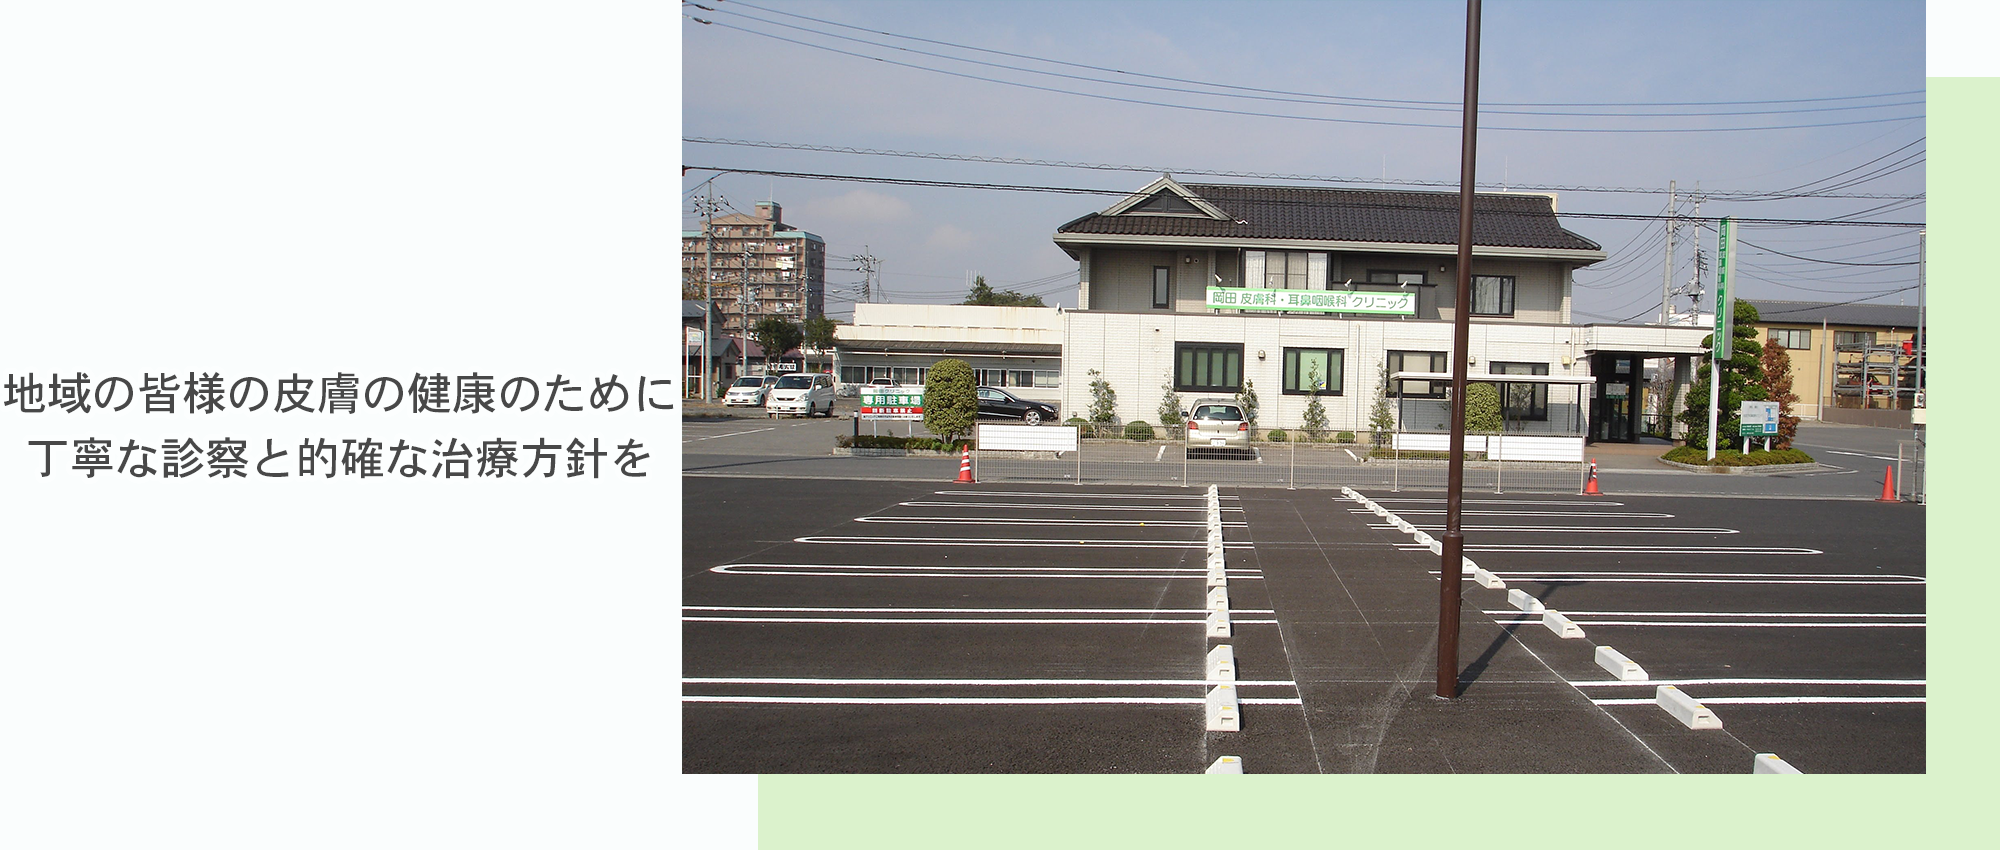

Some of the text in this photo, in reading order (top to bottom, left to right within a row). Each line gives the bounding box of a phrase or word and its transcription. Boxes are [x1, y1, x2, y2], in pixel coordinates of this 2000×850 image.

[1212, 291, 1409, 310] 岡田 皮膚科・耳鼻咽喉科 クリニック
[1715, 294, 1723, 353] クリニック
[862, 395, 921, 406] 専用駐車場
